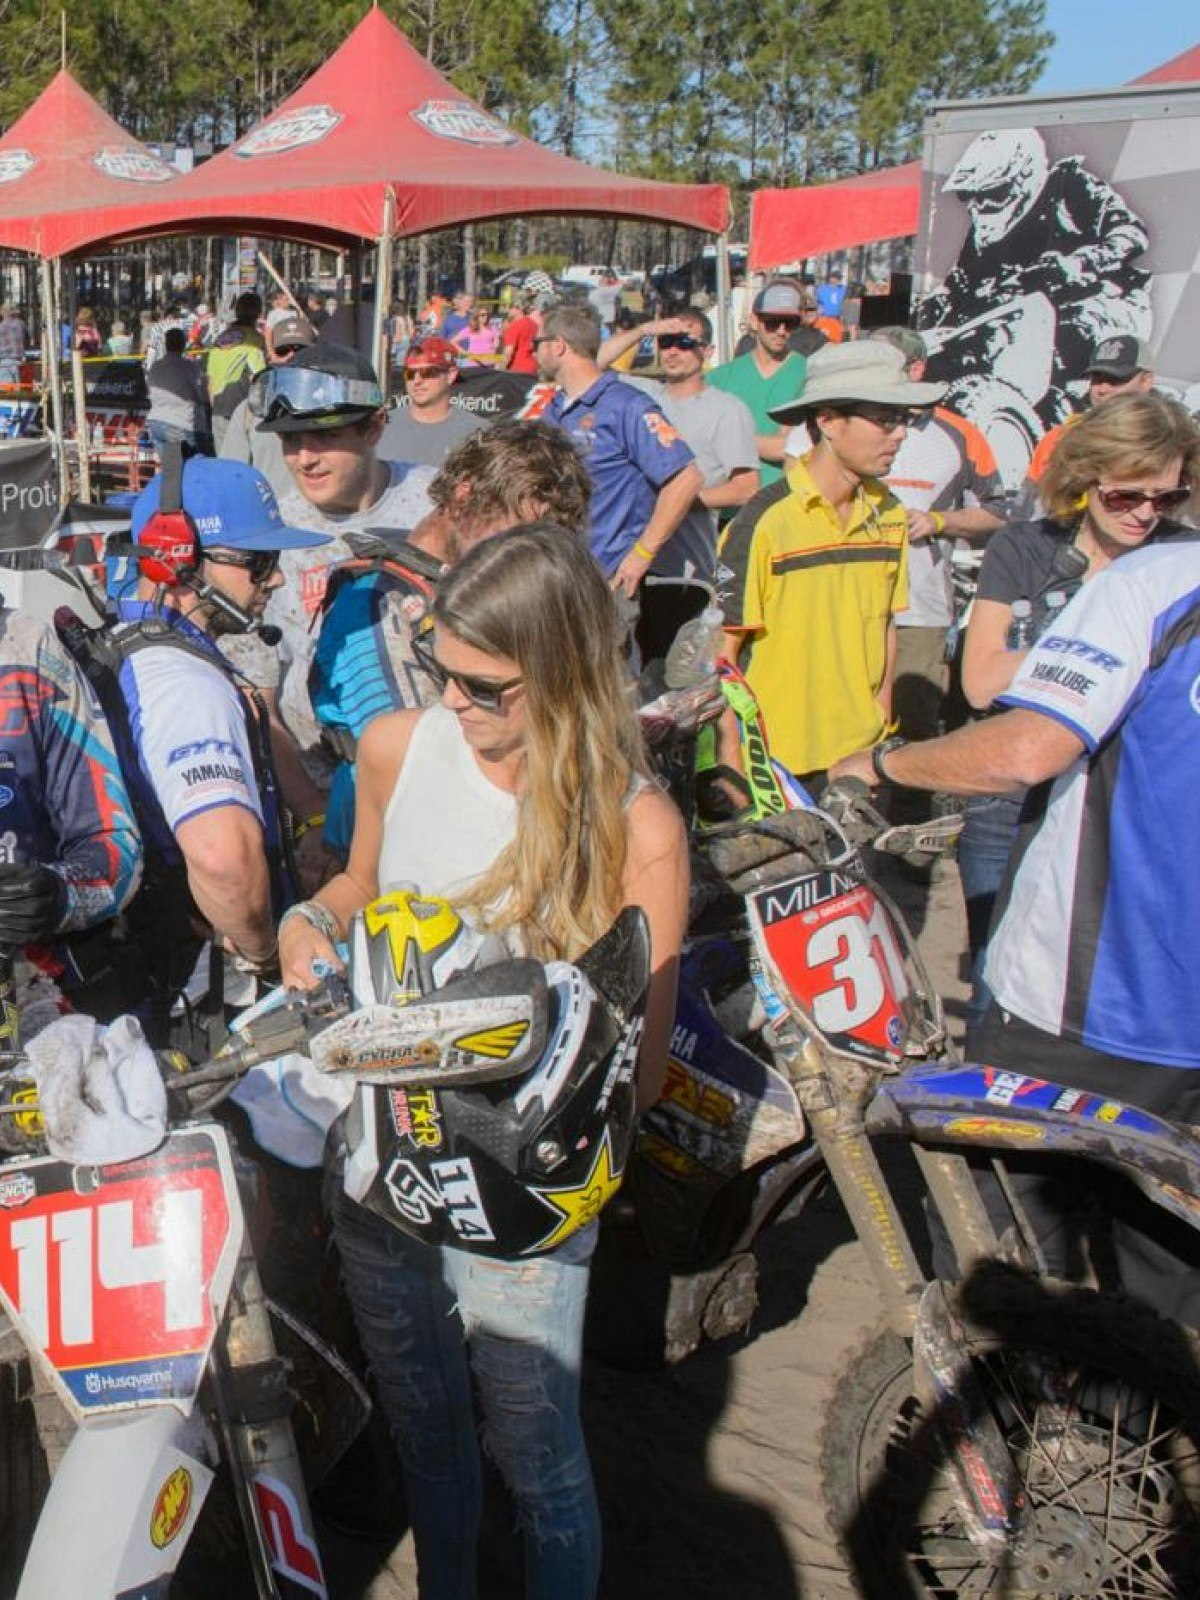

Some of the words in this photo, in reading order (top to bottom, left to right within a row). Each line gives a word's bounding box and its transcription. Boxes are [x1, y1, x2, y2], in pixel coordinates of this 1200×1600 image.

[433, 1163, 489, 1238] 114
[10, 1189, 203, 1350] 114
[101, 1370, 172, 1390] Husqvarna
